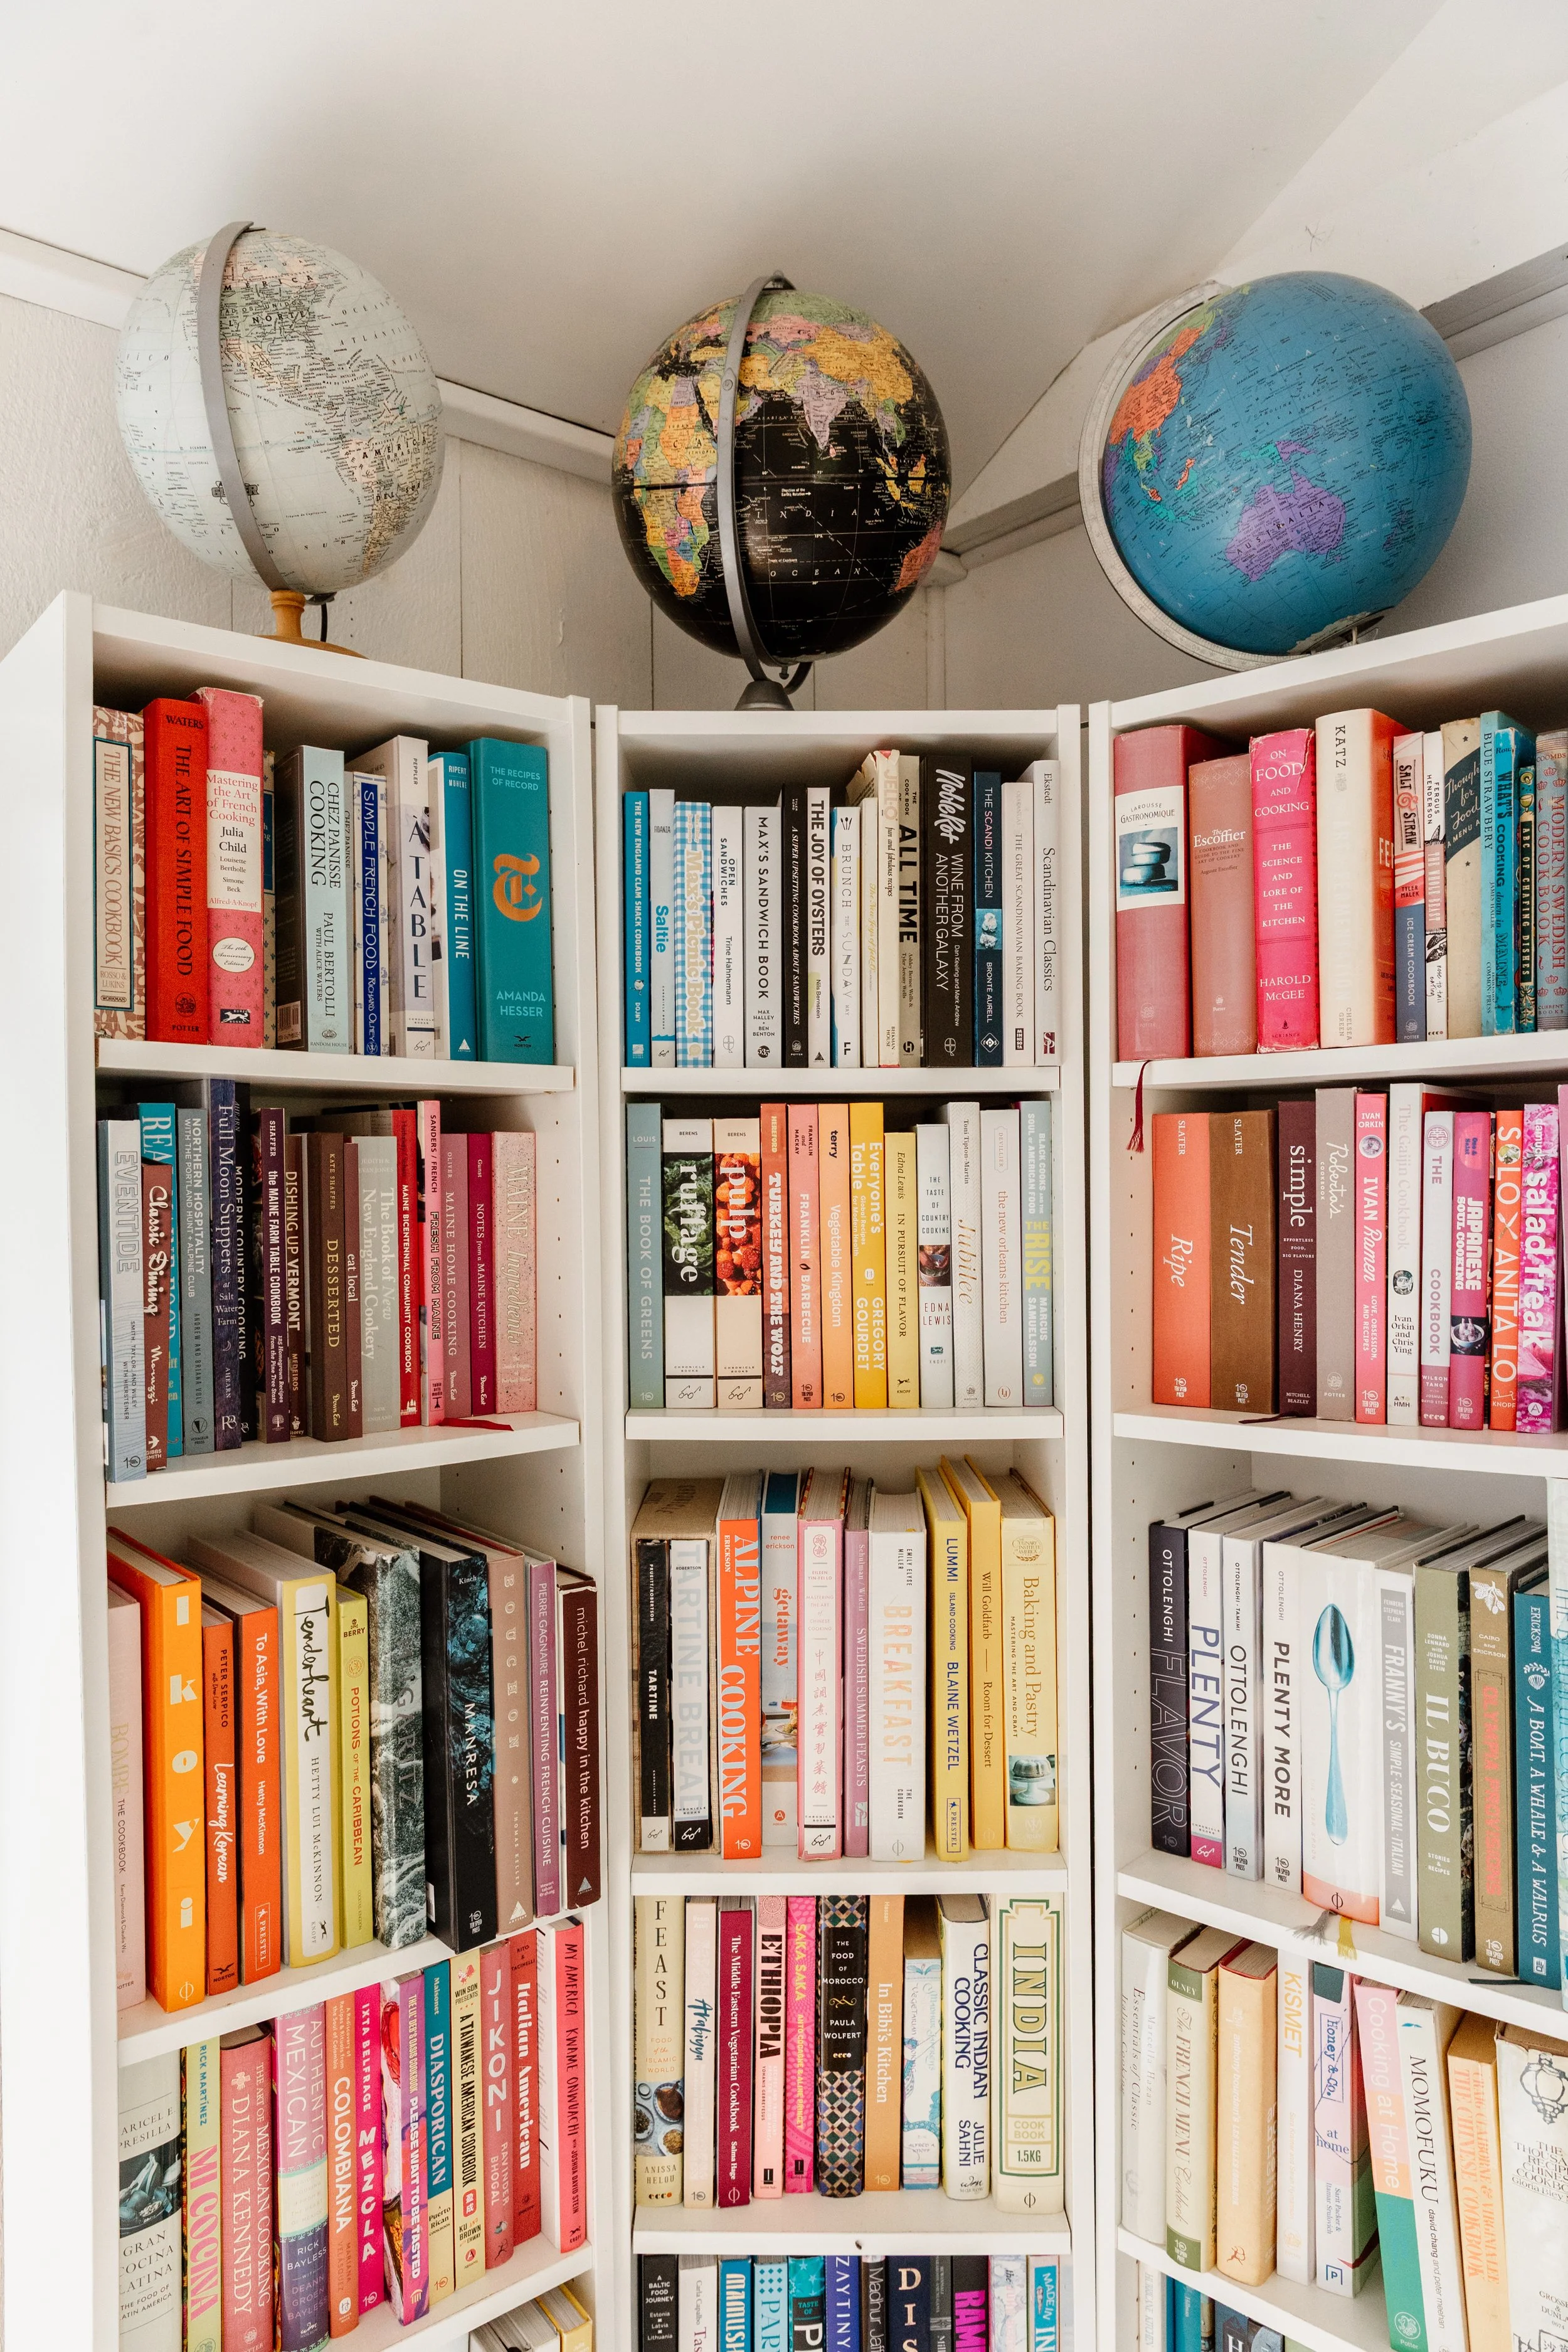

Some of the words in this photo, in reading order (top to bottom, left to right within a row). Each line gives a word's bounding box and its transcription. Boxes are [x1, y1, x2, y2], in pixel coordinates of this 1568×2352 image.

[252, 311, 305, 324] NORTE
[757, 509, 880, 519] INDIAN
[1188, 510, 1229, 532] INDONESIA
[1236, 501, 1325, 556] AUSTRALIA
[770, 568, 861, 578] OCEAN
[103, 752, 120, 782] THE
[175, 745, 191, 776] THE
[1335, 726, 1345, 768] KATZ
[104, 786, 120, 820] NEW
[176, 780, 191, 815] ART
[328, 783, 339, 824] CHEZ
[1044, 773, 1052, 804] Ekstedt
[1484, 771, 1492, 850] STRAWBERY
[176, 821, 191, 844] OF
[221, 826, 244, 837] Julia
[309, 780, 327, 886] COOKING
[758, 817, 769, 862] MAX'S
[811, 800, 824, 830] THE
[104, 825, 122, 874] BASICS
[219, 841, 247, 853] Child
[329, 829, 341, 889] PANISSE
[811, 834, 824, 862] JOY
[1194, 835, 1246, 847] Escoffier
[176, 849, 192, 915] SIMPLE
[453, 869, 467, 891] ON
[812, 866, 825, 885] OF
[1042, 848, 1056, 935] Scandinavian
[105, 879, 123, 965] COOKBOOK
[454, 895, 469, 920] THE
[655, 905, 669, 952] Saltie
[758, 869, 769, 950] SANDWICH
[812, 889, 825, 955] OYSTERS
[176, 920, 193, 976] FOOD
[455, 926, 470, 959] LINE
[1043, 940, 1056, 991] Classics
[758, 956, 769, 999] BOOK
[1259, 977, 1311, 987] HAROLD
[193, 1118, 203, 1189] NORTHERN
[829, 1130, 839, 1158] terry
[1234, 1119, 1242, 1155] SLATER
[897, 1152, 906, 1173] Edna
[897, 1176, 906, 1199] Lewis
[1283, 1145, 1312, 1227] simple
[672, 1165, 706, 1282] ruffage
[720, 1165, 755, 1239] pulp
[1364, 1177, 1378, 1220] IVAN
[1524, 1172, 1553, 1257] salad
[194, 1192, 204, 1274] HOSPITALITY
[800, 1194, 810, 1259] FRANKLIN
[828, 1204, 842, 1268] Vegetable
[347, 1254, 357, 1271] eat
[1163, 1234, 1193, 1287] Ripe
[1230, 1224, 1254, 1305] Tender
[1363, 1226, 1381, 1282] Ramen
[327, 1240, 339, 1348] DESSERTED
[347, 1275, 358, 1302] local
[801, 1275, 811, 1343] BARBECUE
[829, 1271, 844, 1327] Kingdom
[1293, 1269, 1303, 1308] DIANA
[1523, 1265, 1552, 1348] freak
[856, 1297, 869, 1370] GOURDET
[872, 1296, 884, 1370] GREGORY
[1294, 1312, 1303, 1352] HENRY
[946, 1539, 958, 1582] LUMMI
[1020, 1577, 1039, 1640] Baking
[1163, 1549, 1173, 1642] OTTOLENGHI
[256, 1633, 267, 1652] To
[576, 1608, 590, 1654] michel
[773, 1588, 791, 1670] getaway
[255, 1656, 267, 1690] Asia,
[293, 1596, 331, 1742] Tenderheart
[577, 1658, 591, 1705] richard
[1024, 1645, 1039, 1676] and
[256, 1693, 268, 1725] With
[649, 1670, 657, 1720] TARTINE
[947, 1662, 959, 1710] BLAINE
[1020, 1682, 1042, 1738] Pastry
[1192, 1625, 1220, 1787] PLENTY
[1274, 1641, 1290, 1737] PLENTY
[1385, 1644, 1406, 1733] FRANNY'S
[1426, 1693, 1447, 1728] IL
[574, 1710, 591, 1752] happy
[948, 1715, 960, 1770] WETZEL
[1230, 1645, 1248, 1796] OTTOLENGHI
[257, 1729, 268, 1763] Love
[465, 1703, 478, 1806] MANRESA
[579, 1755, 591, 1769] in
[209, 1763, 234, 1827] Learning
[580, 1772, 592, 1794] the
[1274, 1747, 1290, 1818] MORE
[1426, 1736, 1450, 1833] BUCO
[580, 1797, 594, 1849] kitchen
[216, 1831, 231, 1882] Korean
[731, 1936, 741, 1953] The
[731, 1956, 741, 1989] Middle
[760, 1934, 782, 2059] ETHIOPIA
[878, 1983, 893, 1997] In
[973, 1944, 988, 2025] CLASSIC
[361, 2004, 370, 2035] IXTA
[517, 1982, 532, 2058] Italian
[729, 1992, 740, 2027] Eastern
[877, 2003, 892, 2042] Bibi's
[955, 1977, 971, 2069] COOKING
[1013, 1942, 1047, 2094] INDIA
[1174, 2008, 1191, 2032] The
[199, 2045, 207, 2070] RICK
[728, 2030, 740, 2080] Vegetarian
[1323, 2019, 1338, 2058] Honey
[310, 2020, 324, 2150] AUTHENTIC
[363, 2040, 371, 2112] BELFRAGE
[876, 2046, 892, 2103] Kitchen
[973, 2030, 988, 2099] INDIAN
[1173, 2035, 1190, 2104] FRENCH
[1325, 2077, 1339, 2096] Co.
[1327, 2065, 1338, 2074] &
[199, 2073, 209, 2126] MARTÍNEZ
[286, 2027, 307, 2159] MEXICAN
[430, 2033, 445, 2185] DIASPORICAN
[519, 2065, 533, 2169] American
[729, 2083, 740, 2132] Cookbook
[231, 2097, 250, 2184] DIANA
[958, 2119, 970, 2167] SAHNI
[973, 2122, 985, 2164] JULIE
[1175, 2107, 1190, 2163] MENU
[1410, 2055, 1438, 2204] MOMOFUKU
[334, 2077, 352, 2233] COLOMBIANA
[1173, 2164, 1191, 2222] Cookbook
[1428, 2209, 1437, 2230] david
[233, 2191, 252, 2315] KENNEDY
[1428, 2233, 1439, 2257] chang
[645, 2296, 674, 2304] JOURNEY
